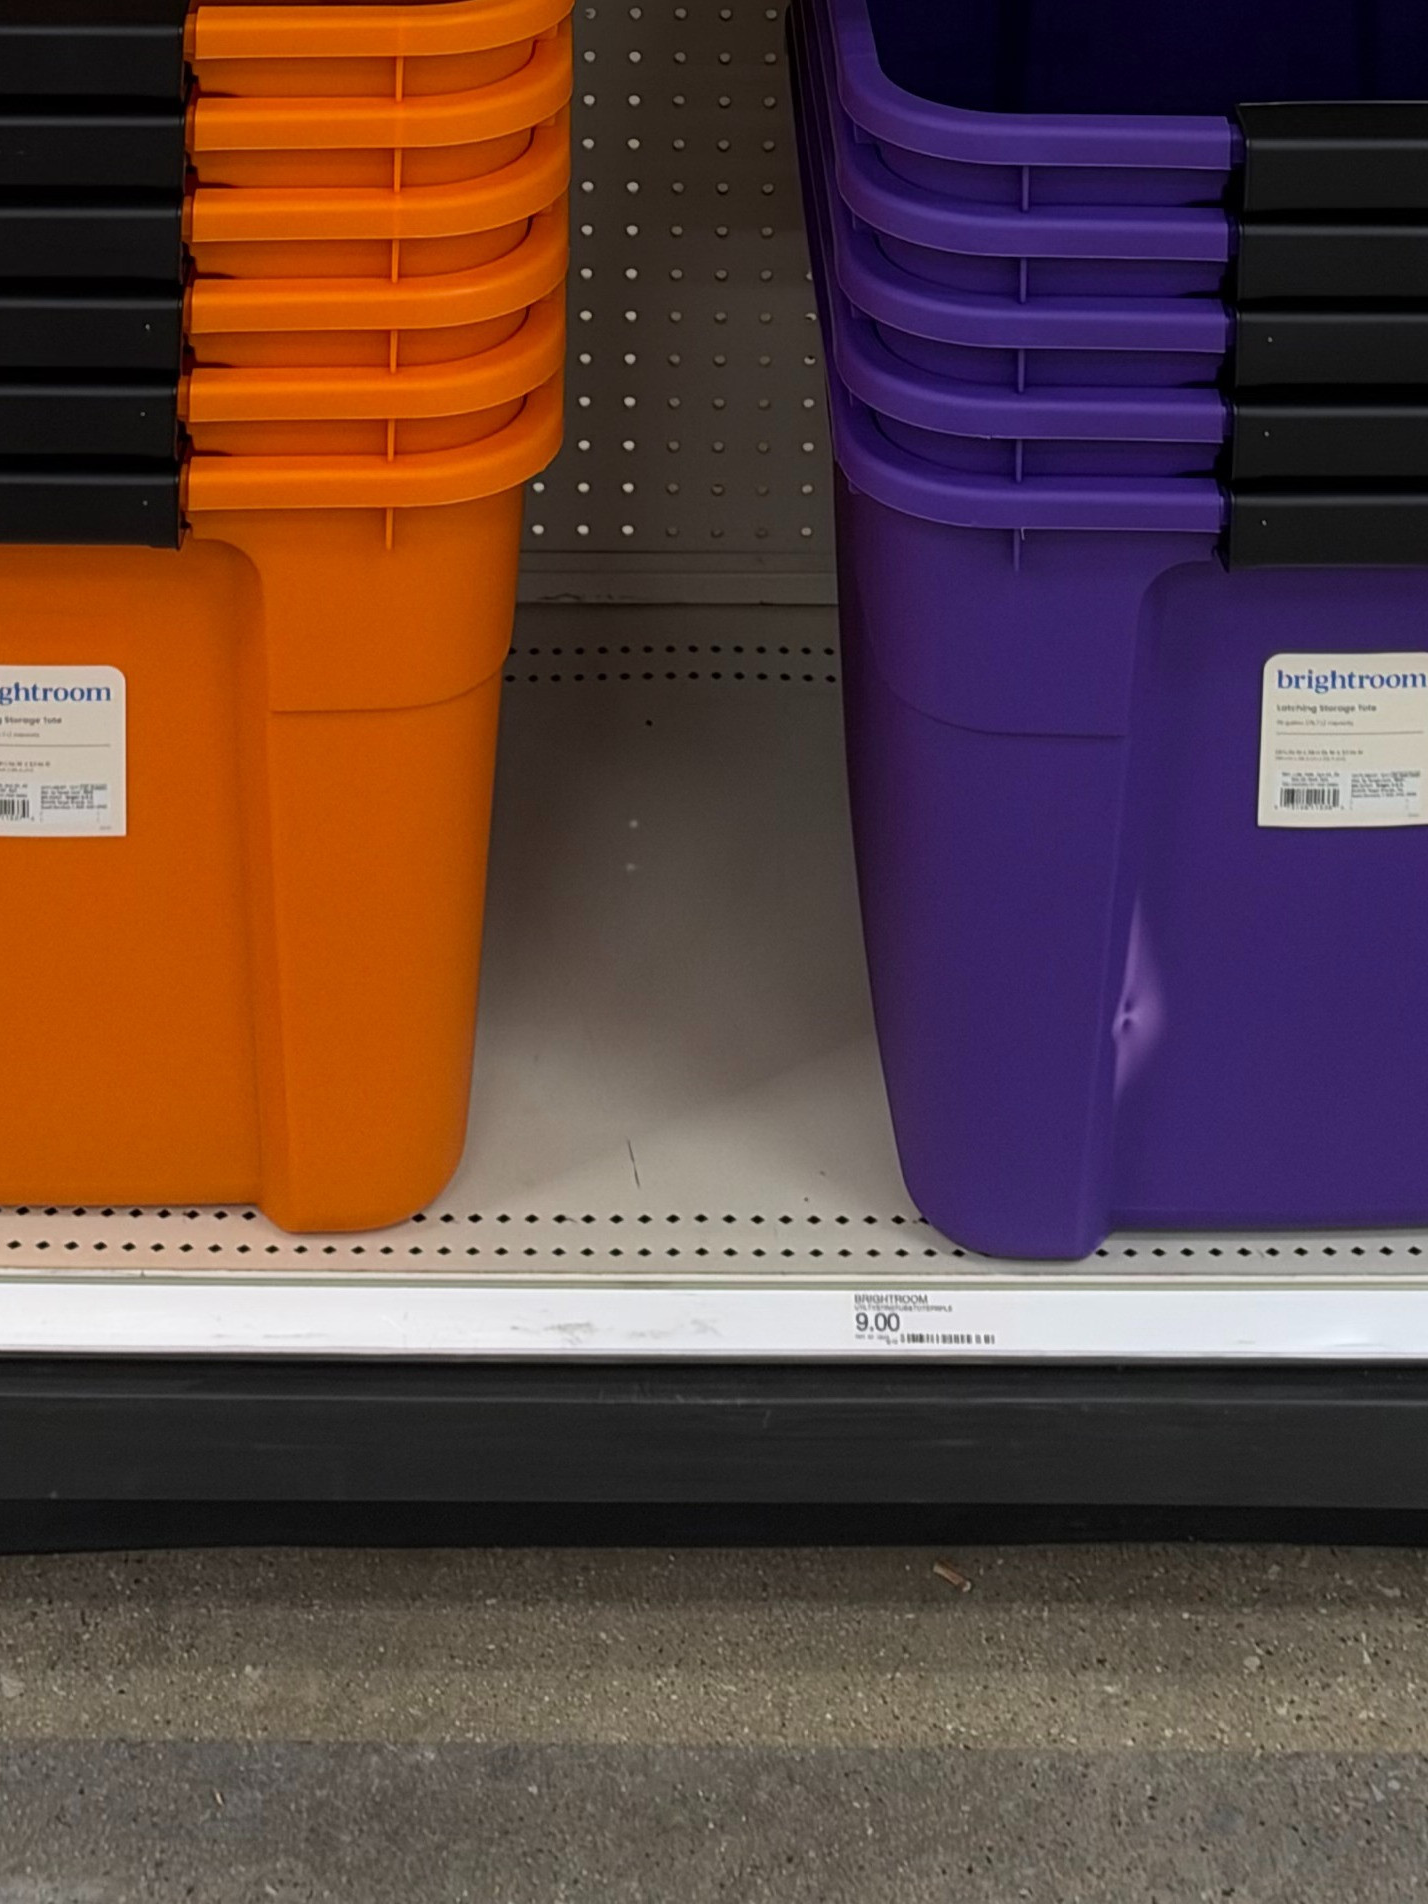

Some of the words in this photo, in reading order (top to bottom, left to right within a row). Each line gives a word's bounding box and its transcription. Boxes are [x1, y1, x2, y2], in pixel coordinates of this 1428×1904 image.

[1277, 669, 1427, 694] brightroom
[1276, 703, 1317, 714] Latching
[1319, 704, 1356, 714] Storage
[1358, 703, 1377, 712] Tote
[4, 716, 41, 726] Storage
[854, 1293, 928, 1304] BRIGHTROOM
[855, 1311, 901, 1332] 9.00
